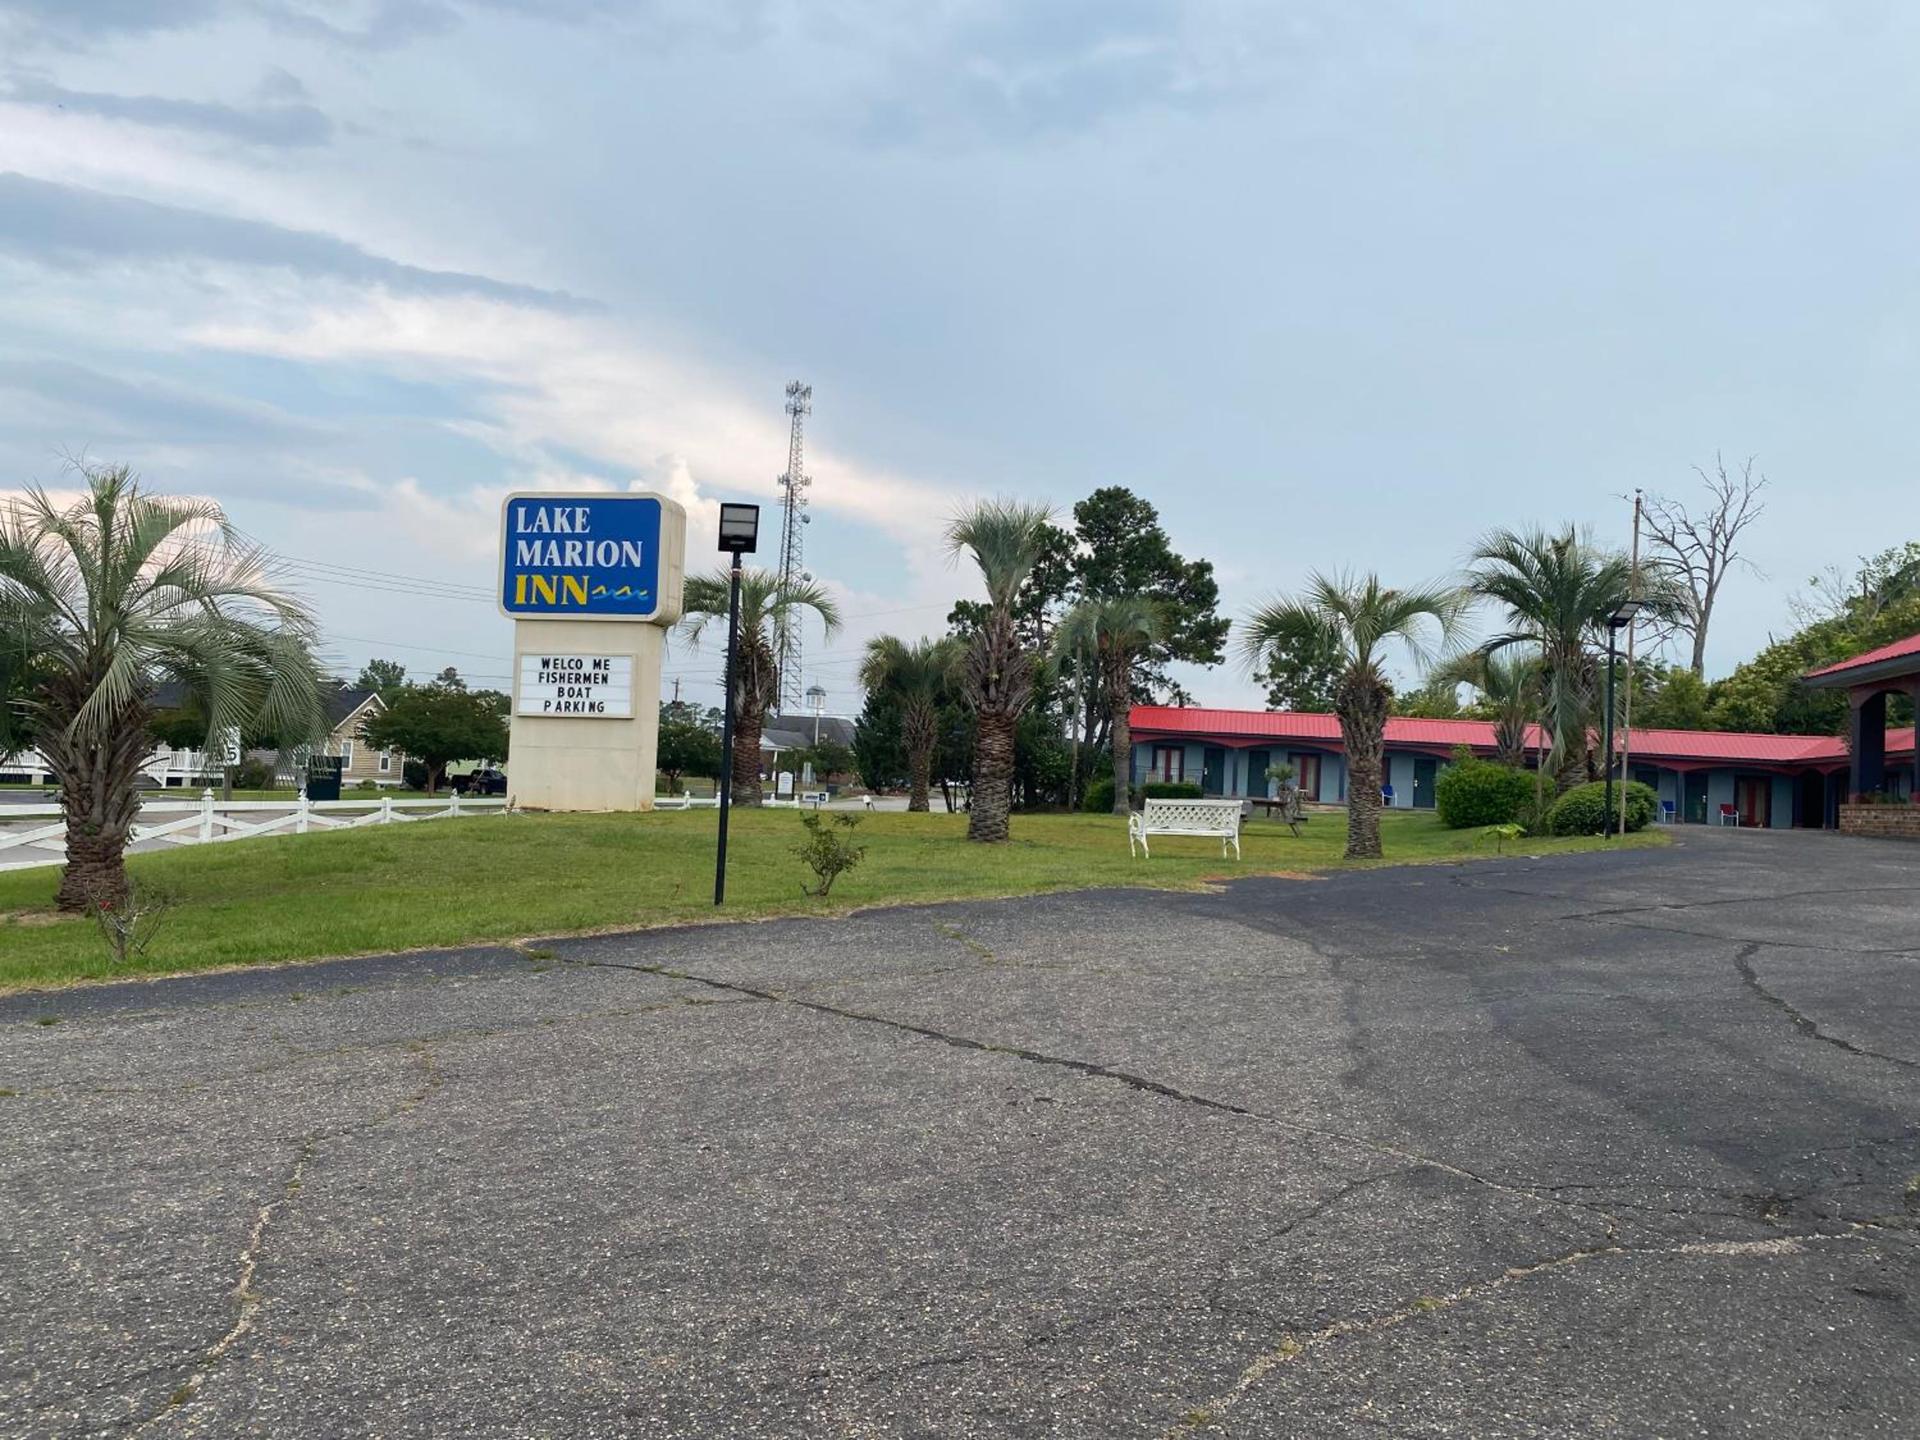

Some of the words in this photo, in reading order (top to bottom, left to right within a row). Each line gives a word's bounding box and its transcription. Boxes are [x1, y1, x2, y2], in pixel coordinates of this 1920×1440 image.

[516, 506, 591, 534] LAKE
[515, 539, 643, 567] MARION
[514, 574, 590, 605] INN
[538, 671, 609, 685] FISHERMEN
[557, 686, 592, 698] BOAT
[543, 700, 605, 713] PARKING
